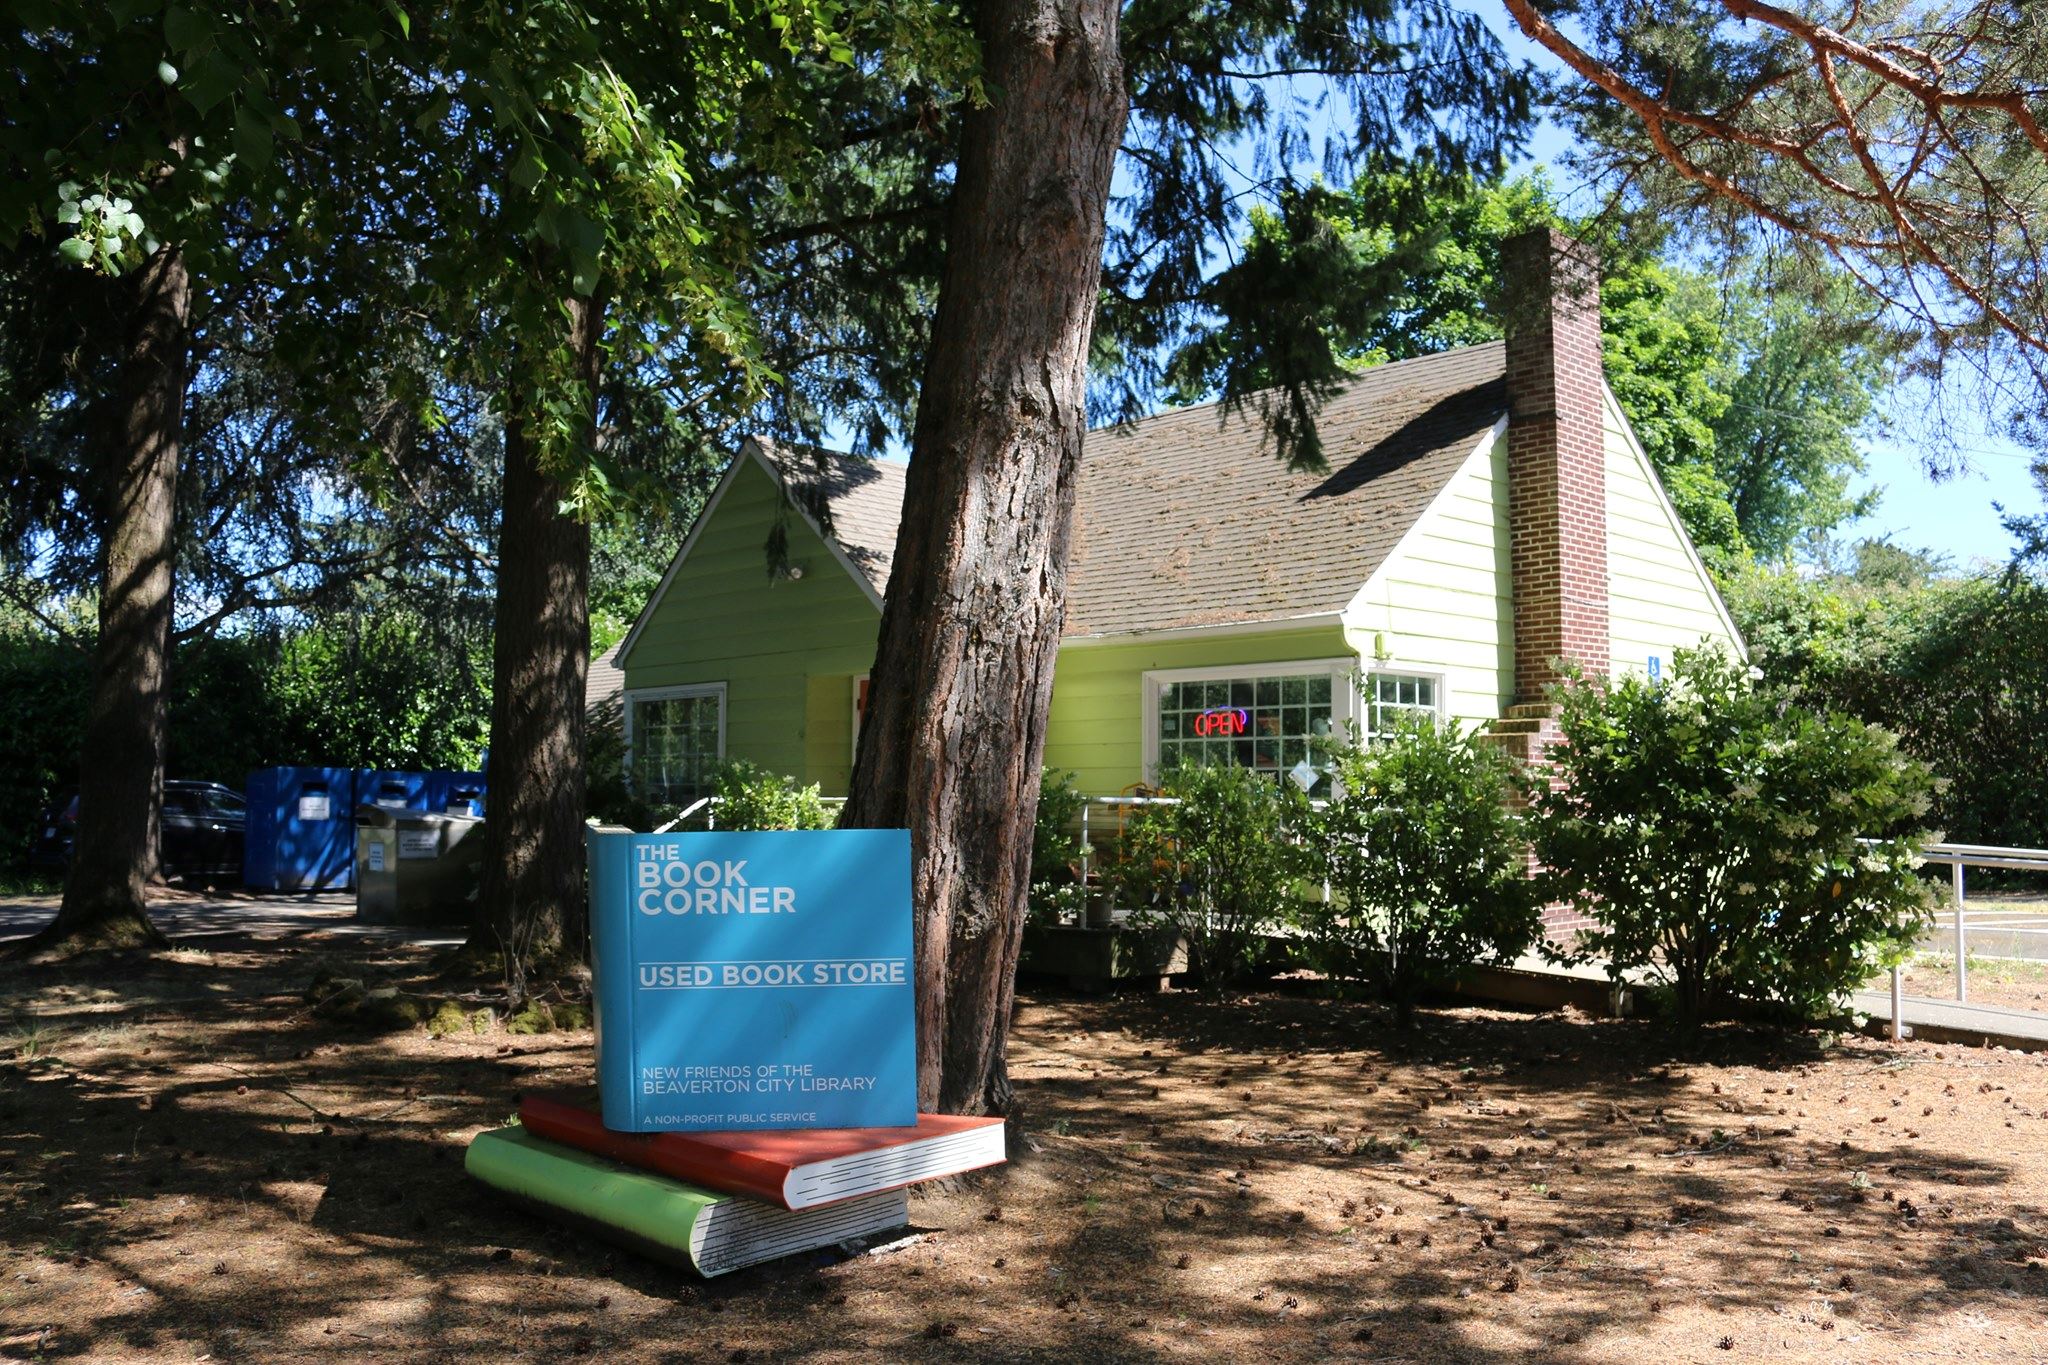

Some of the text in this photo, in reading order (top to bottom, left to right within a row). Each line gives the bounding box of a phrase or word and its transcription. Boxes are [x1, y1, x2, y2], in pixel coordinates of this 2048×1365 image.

[1195, 712, 1243, 736] OPEN
[636, 844, 680, 861] THE
[638, 860, 749, 889] BOOK
[638, 886, 796, 916] CORNER
[639, 962, 906, 987] USED BOOK STORE
[643, 1064, 813, 1079] NEW FRIENDS OF THE
[643, 1077, 877, 1095] BEAVERTON CITY LIBRARY
[643, 1112, 817, 1125] A NON-PROFIT PUBLIC SERVICE
